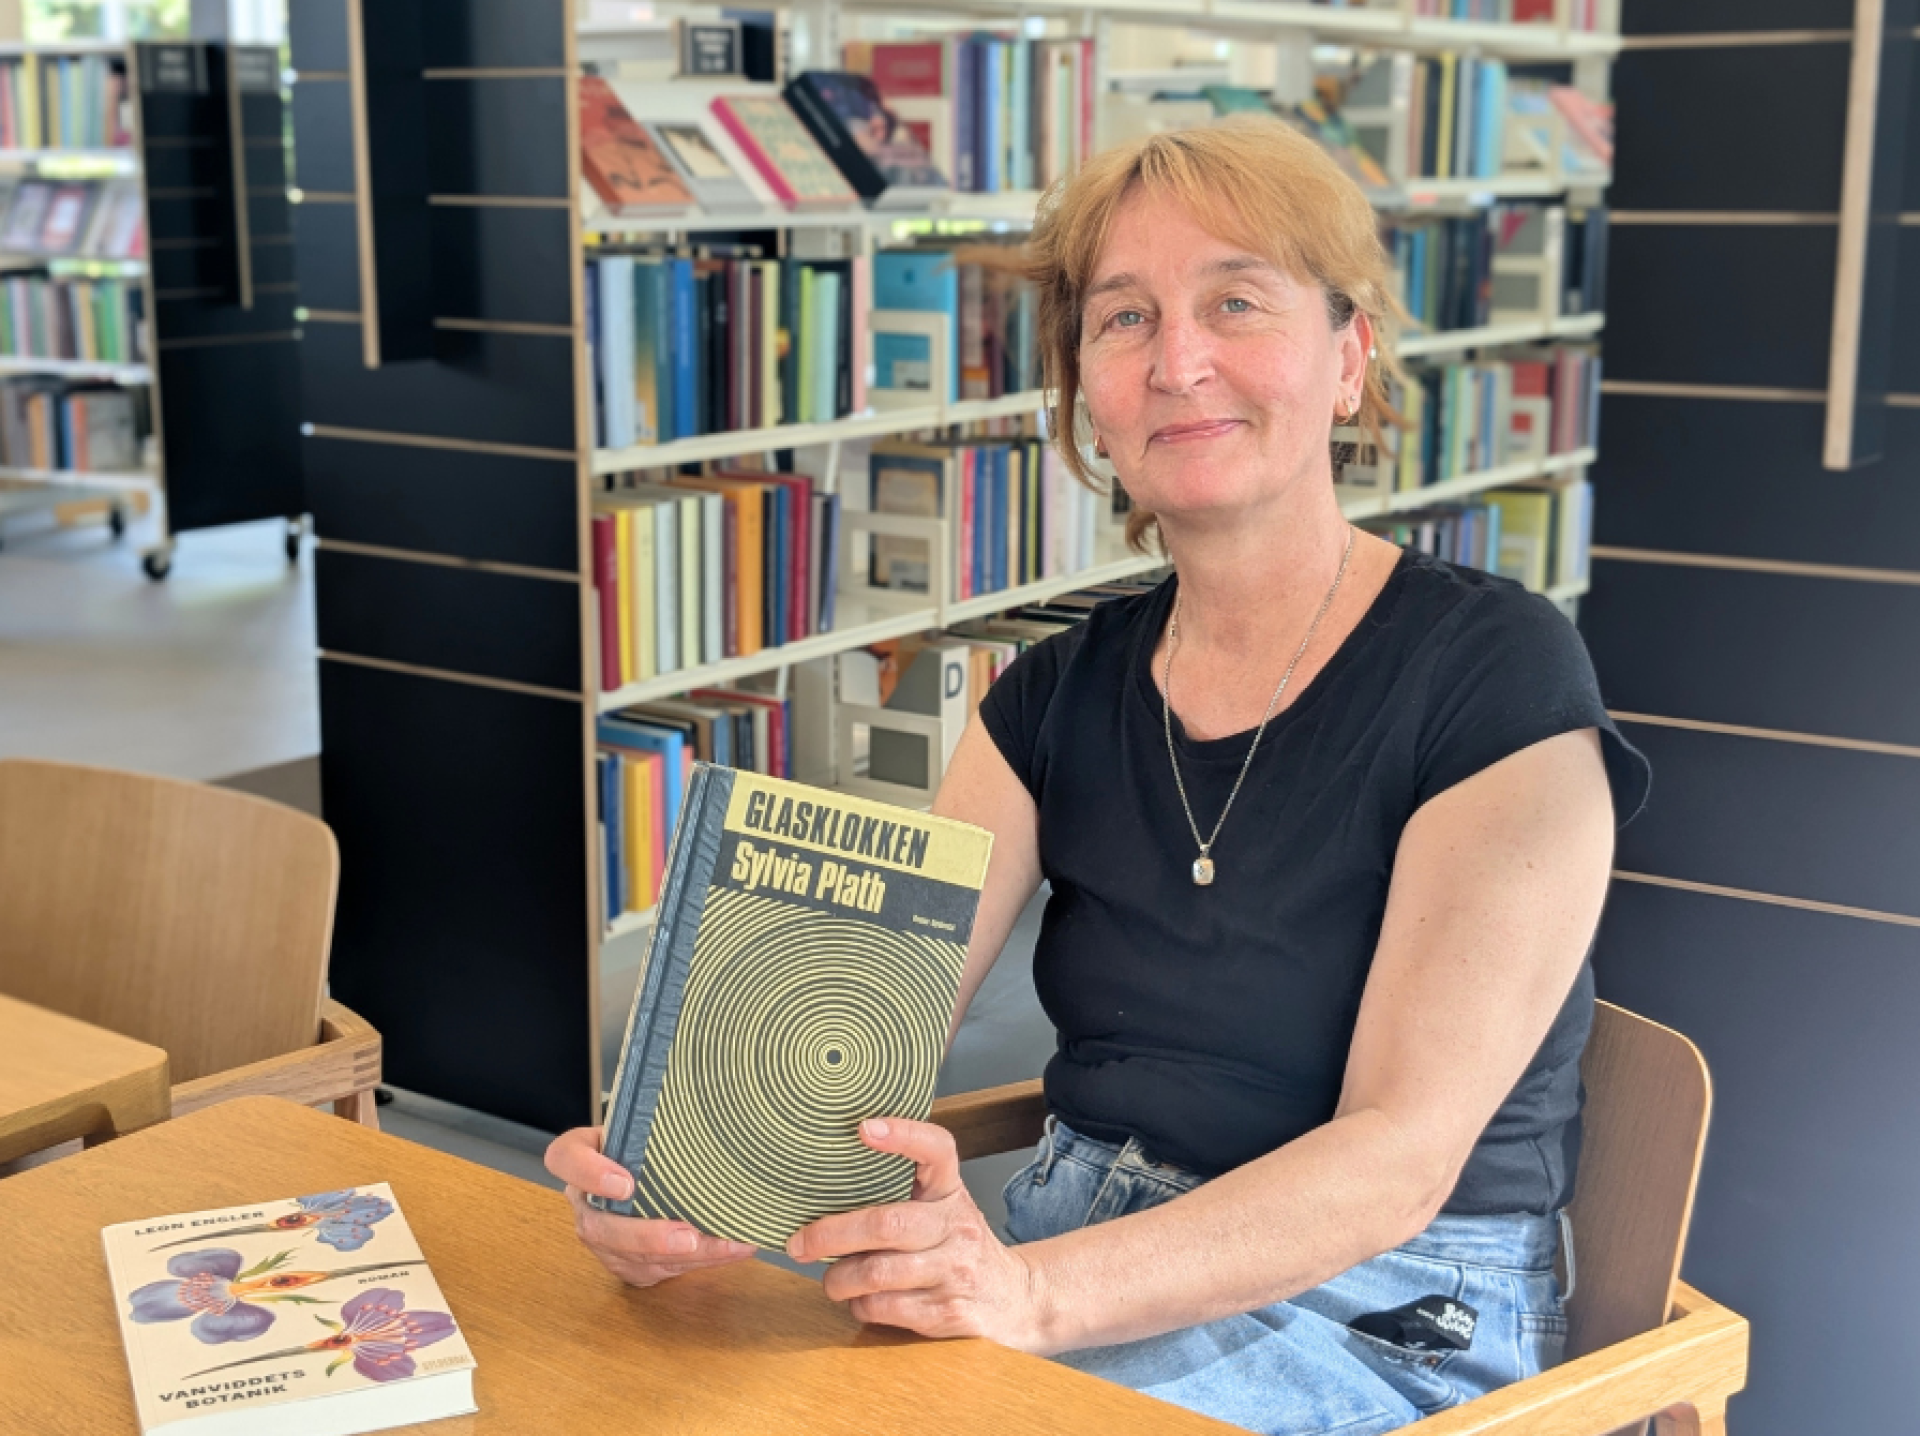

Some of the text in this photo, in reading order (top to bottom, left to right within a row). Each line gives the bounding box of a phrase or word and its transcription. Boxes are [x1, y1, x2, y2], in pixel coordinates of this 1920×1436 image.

[945, 661, 963, 700] D
[743, 790, 930, 869] GLASKLOKKEN
[732, 841, 886, 914] Sylvia Plath
[134, 1210, 265, 1236] LEON ENGLER
[158, 1369, 306, 1403] VANVIDDETS
[185, 1383, 288, 1409] BOTANIK
